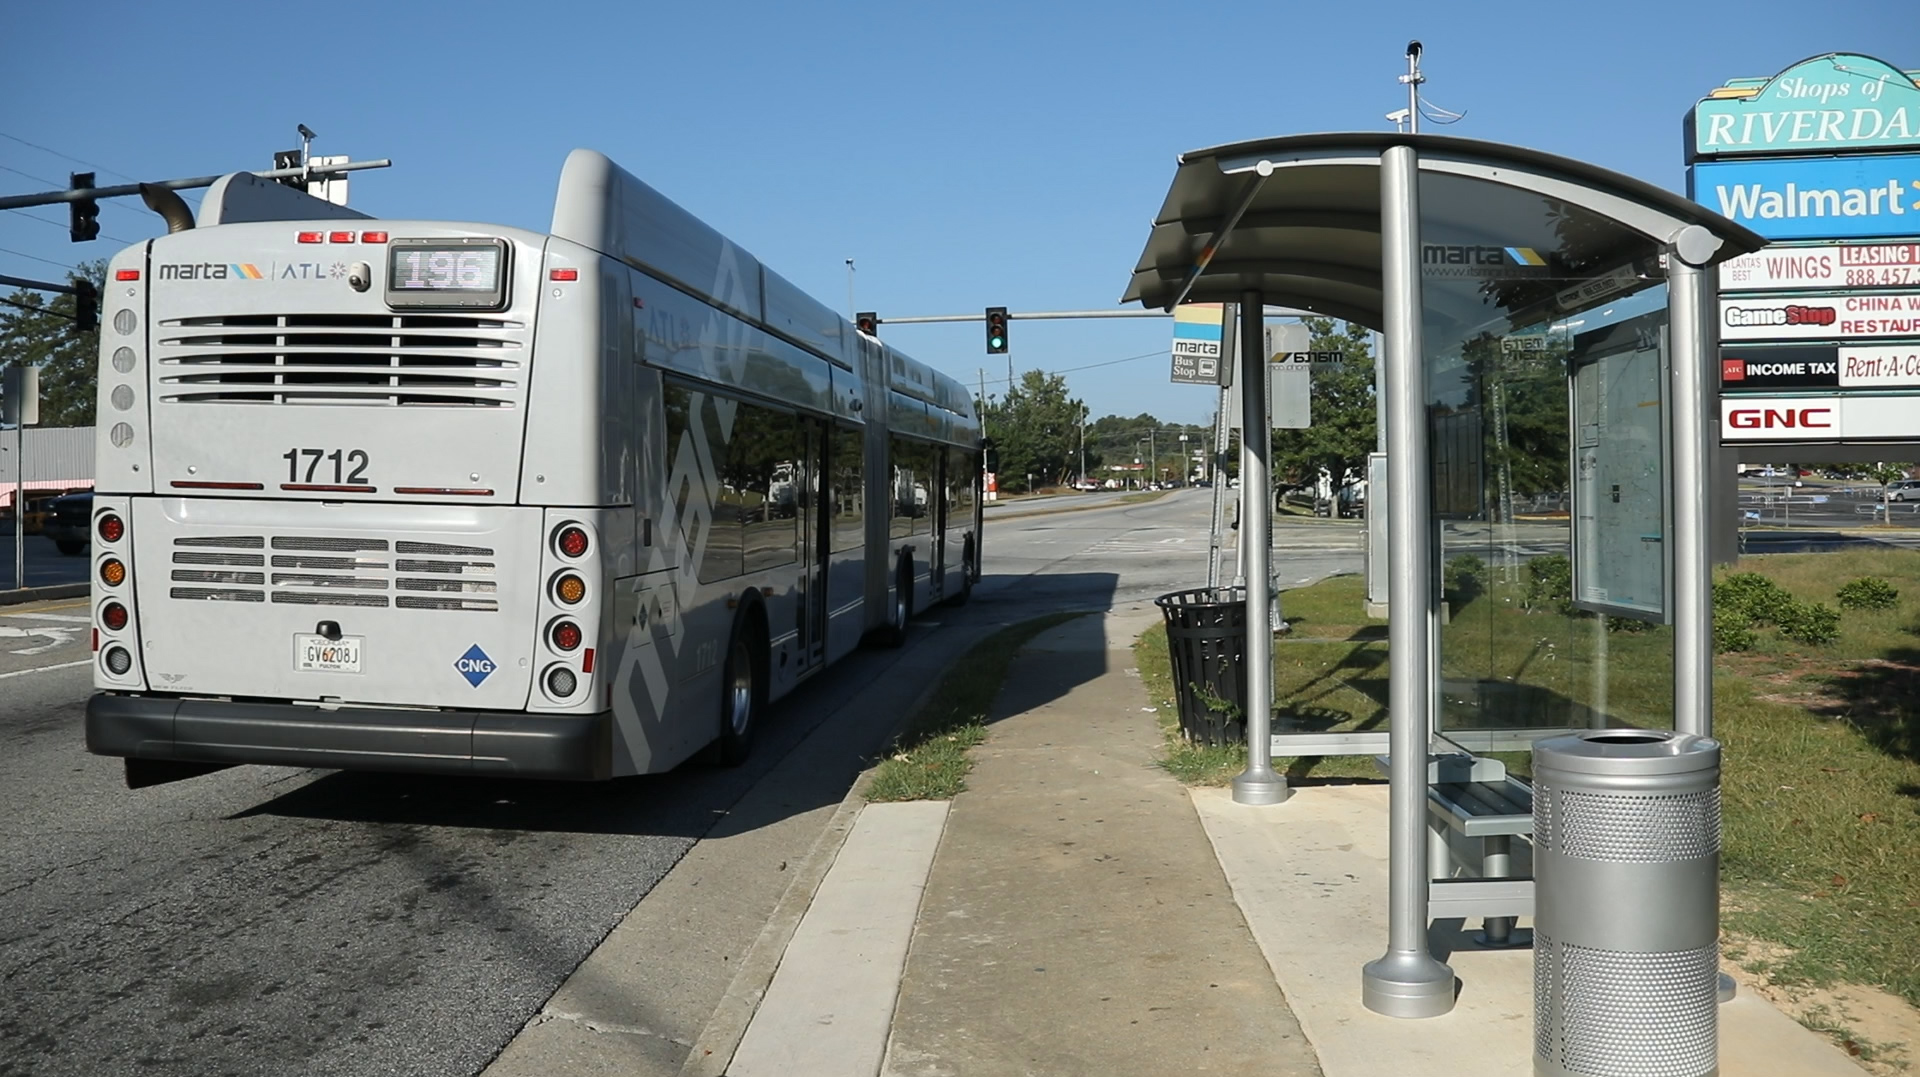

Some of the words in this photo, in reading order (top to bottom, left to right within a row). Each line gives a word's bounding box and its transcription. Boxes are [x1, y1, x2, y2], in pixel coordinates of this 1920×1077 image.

[1776, 77, 1850, 104] Shops
[1861, 74, 1890, 101] of
[1705, 106, 1920, 146] RIVERDA
[1716, 179, 1904, 220] Walmart
[1423, 245, 1504, 265] marta
[1843, 245, 1910, 265] LEASING
[159, 263, 228, 280] marta
[281, 263, 326, 279] ATL
[405, 250, 482, 288] 196
[1732, 270, 1752, 281] BEST
[1766, 256, 1832, 279] WINGS
[1846, 267, 1920, 286] 888.457.
[1846, 298, 1902, 311] CHINA
[1725, 305, 1836, 326] GameStop
[1176, 342, 1218, 354] marta
[1175, 356, 1194, 366] Bus
[1746, 363, 1805, 376] INCOME
[1808, 362, 1836, 375] TAX
[1173, 366, 1196, 378] Stop
[1728, 408, 1831, 429] GNC
[283, 448, 369, 484] 1712
[308, 646, 358, 663] GV6208J
[458, 658, 491, 673] CNG
